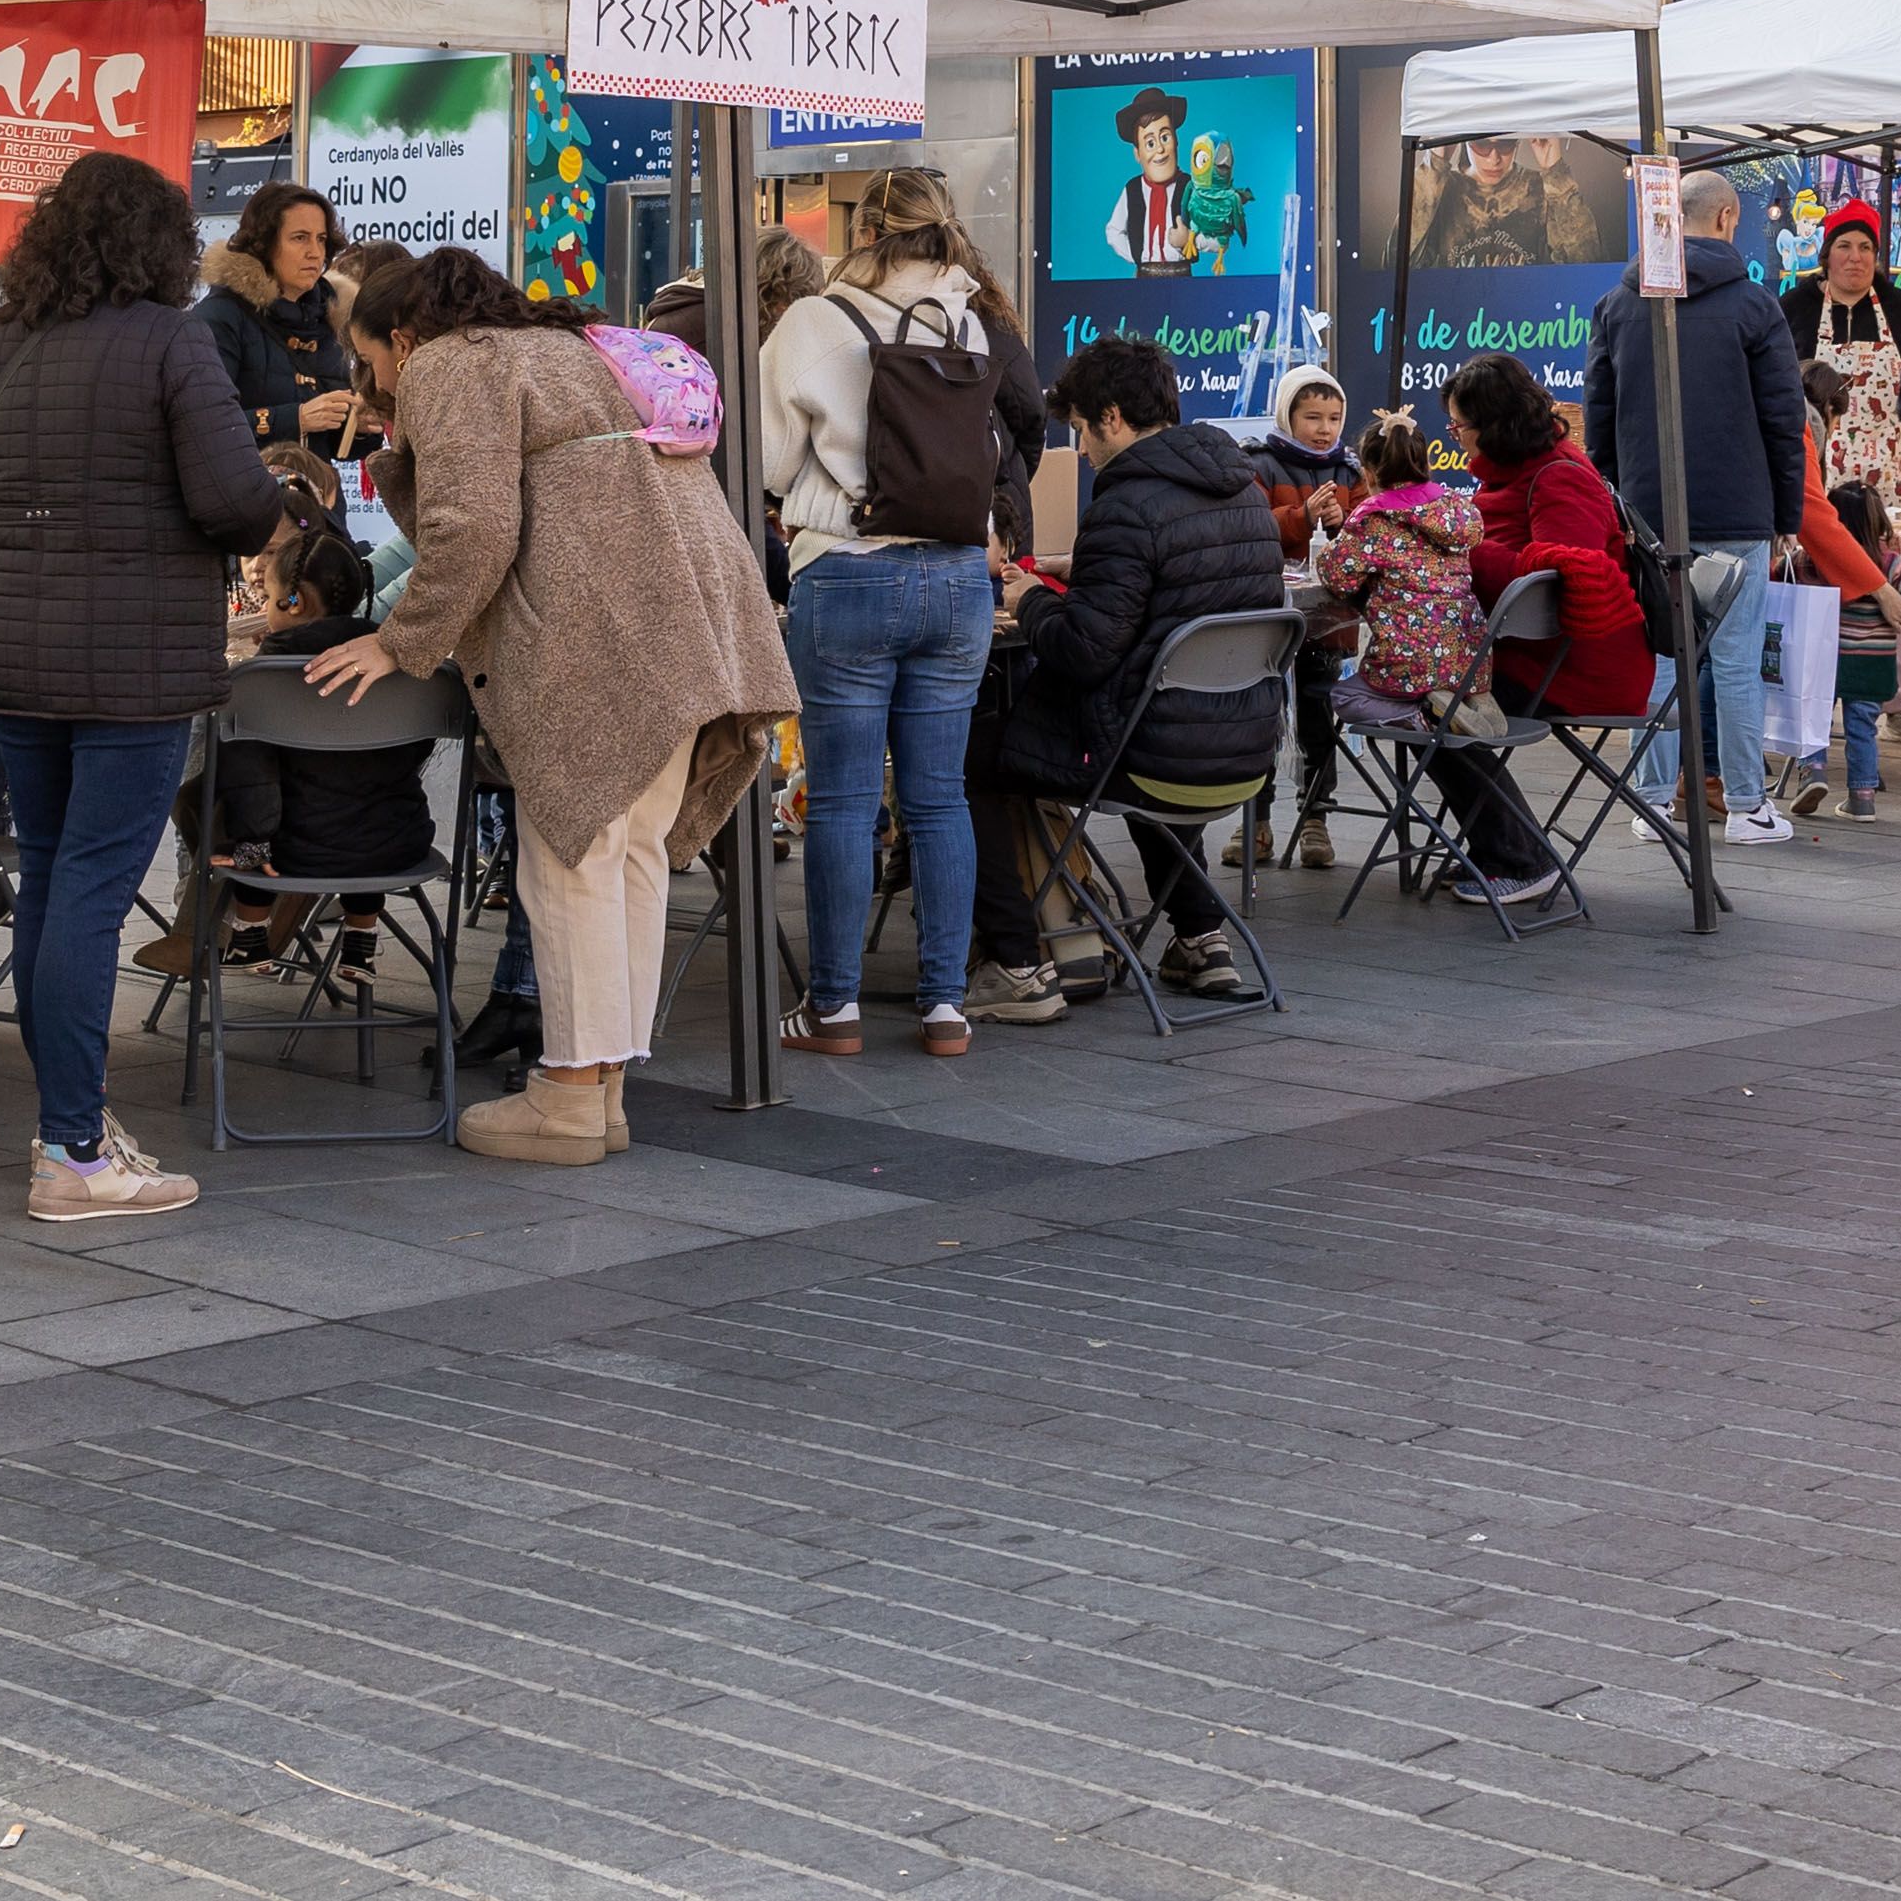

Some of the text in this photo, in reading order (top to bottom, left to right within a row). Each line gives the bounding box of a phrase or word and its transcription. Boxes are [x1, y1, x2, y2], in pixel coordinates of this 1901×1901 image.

[4, 142, 81, 161] RECERQUES
[328, 142, 465, 165] Cerdanyola del Vallès
[328, 176, 363, 206] diu
[371, 175, 407, 204] NO
[352, 211, 455, 243] genocidi
[462, 210, 499, 240] del
[1418, 308, 1460, 350] de
